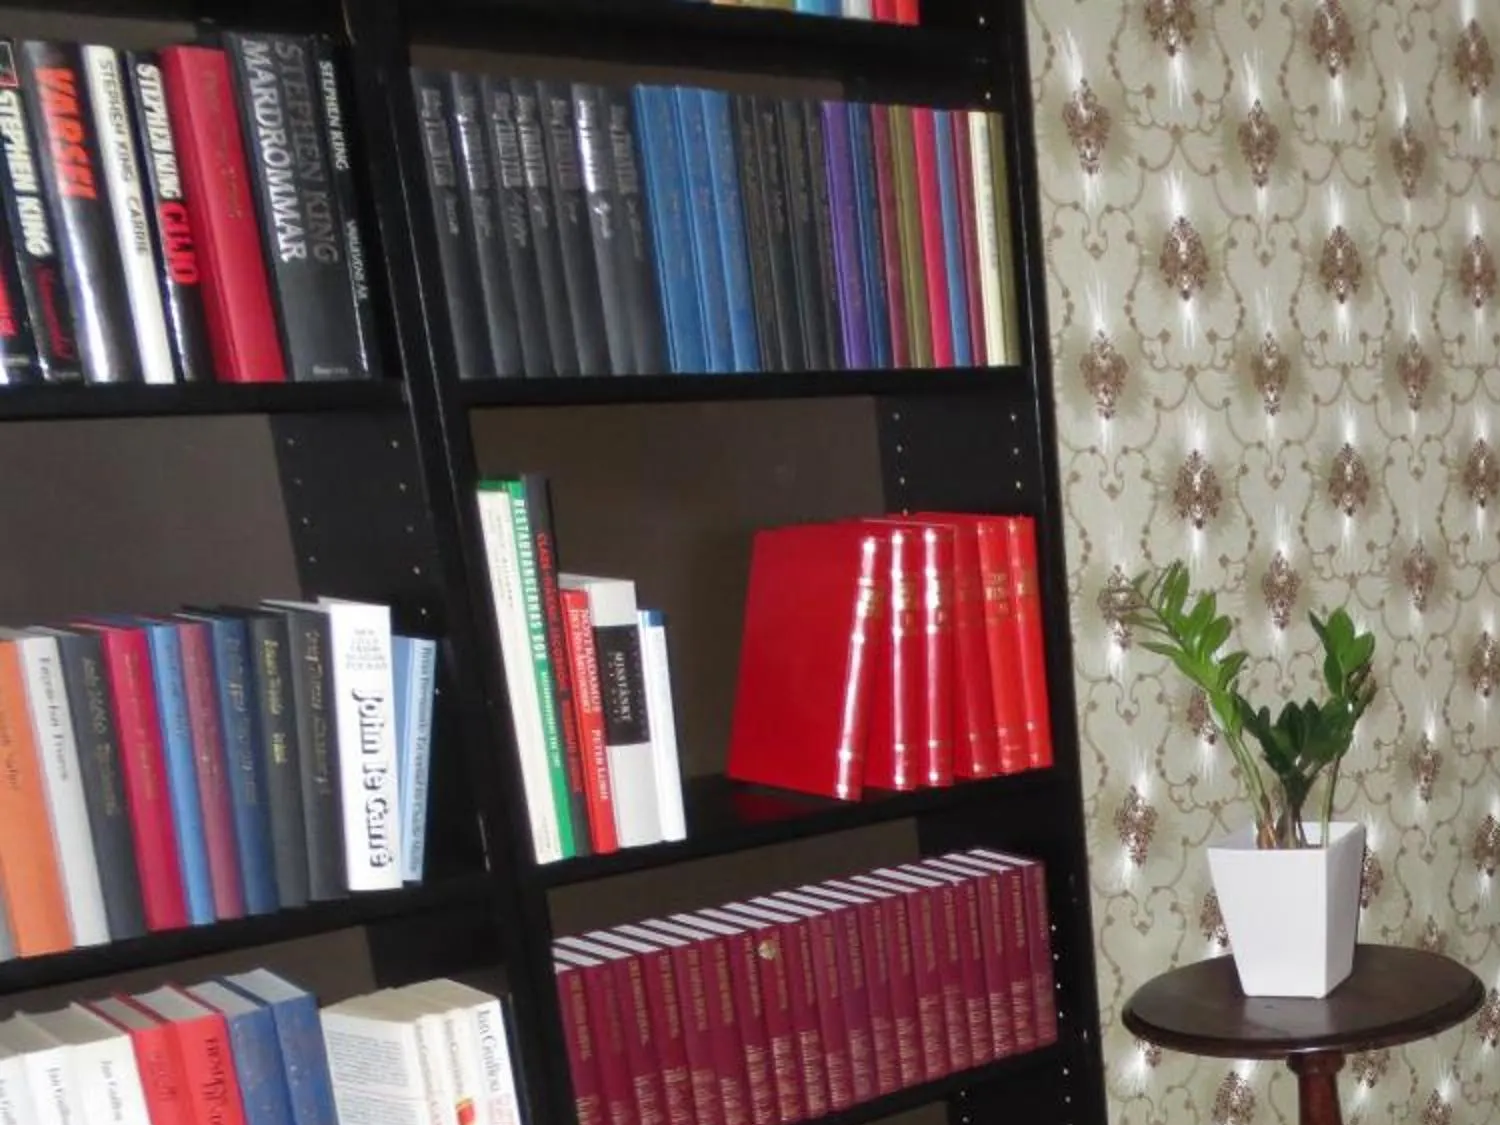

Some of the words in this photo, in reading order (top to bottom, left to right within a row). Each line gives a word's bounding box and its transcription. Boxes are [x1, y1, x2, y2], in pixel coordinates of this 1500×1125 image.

[136, 63, 174, 151] STEPHEN
[318, 60, 340, 132] STEPHEN
[330, 131, 349, 171] KING
[153, 152, 184, 200] KING
[241, 38, 307, 263] MARDRÖMMAR
[274, 40, 325, 182] STEPHEN
[300, 190, 339, 264] KING
[16, 195, 53, 257] KING
[352, 686, 385, 755] John
[363, 765, 388, 791] le
[365, 798, 394, 869] Carré
